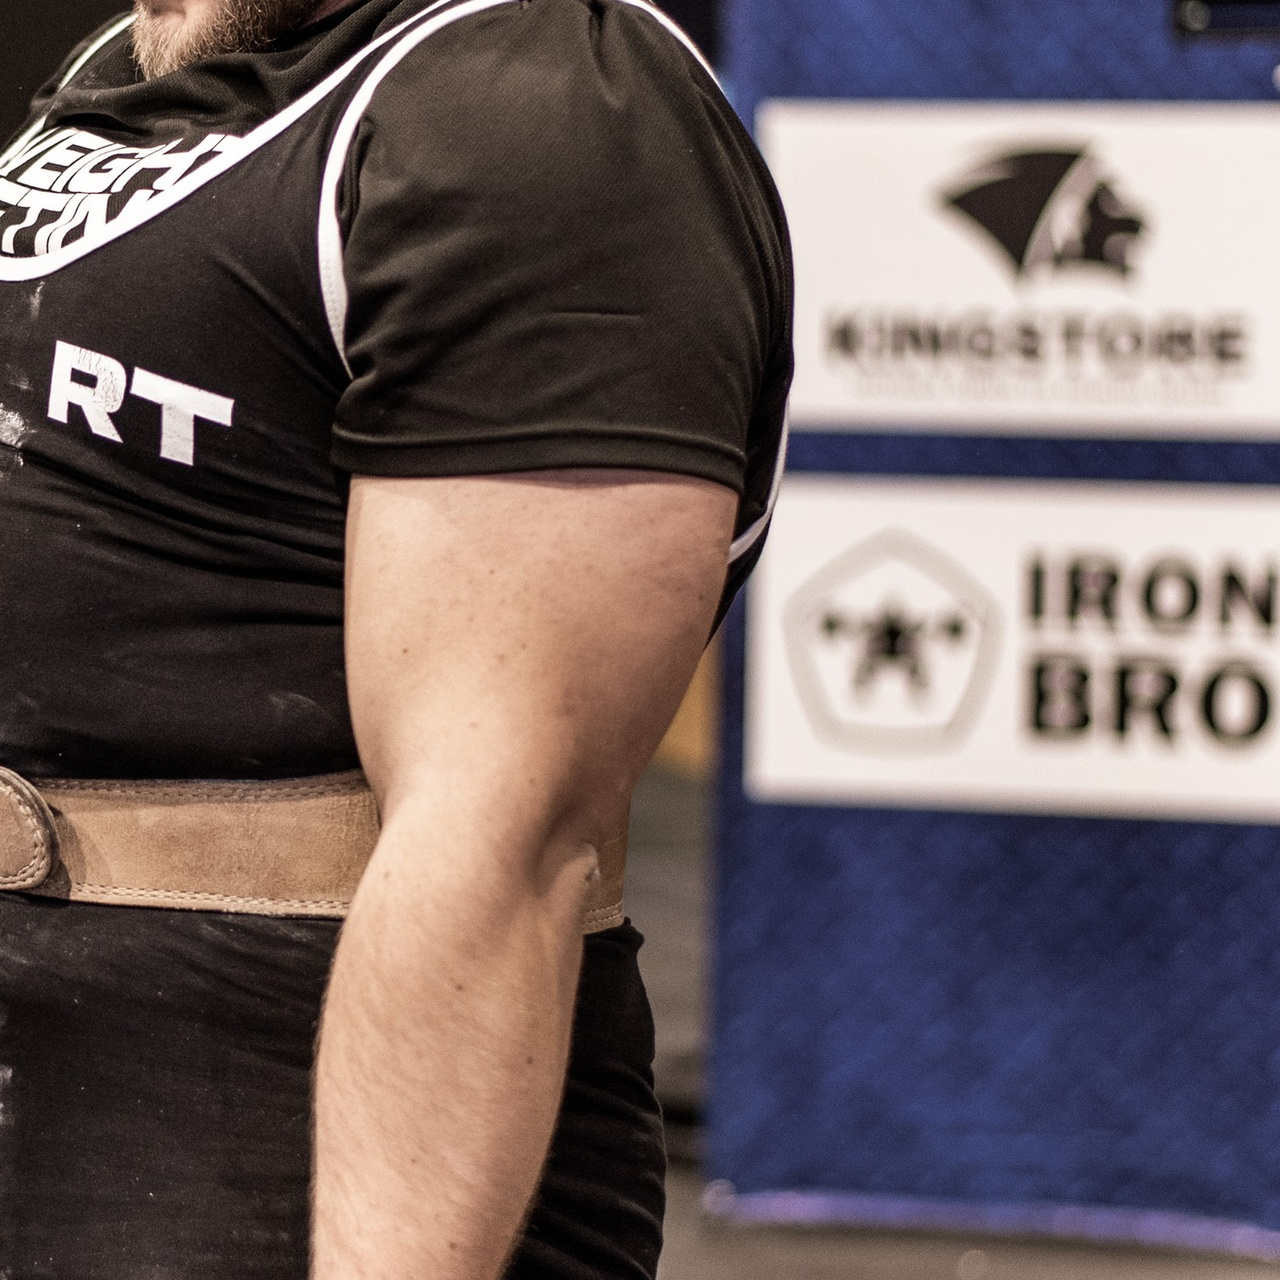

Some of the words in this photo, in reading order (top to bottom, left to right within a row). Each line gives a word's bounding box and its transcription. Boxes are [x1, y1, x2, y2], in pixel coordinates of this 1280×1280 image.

[47, 340, 235, 466] RT
[1026, 554, 1280, 630] IRON
[1026, 658, 1274, 748] BRO
